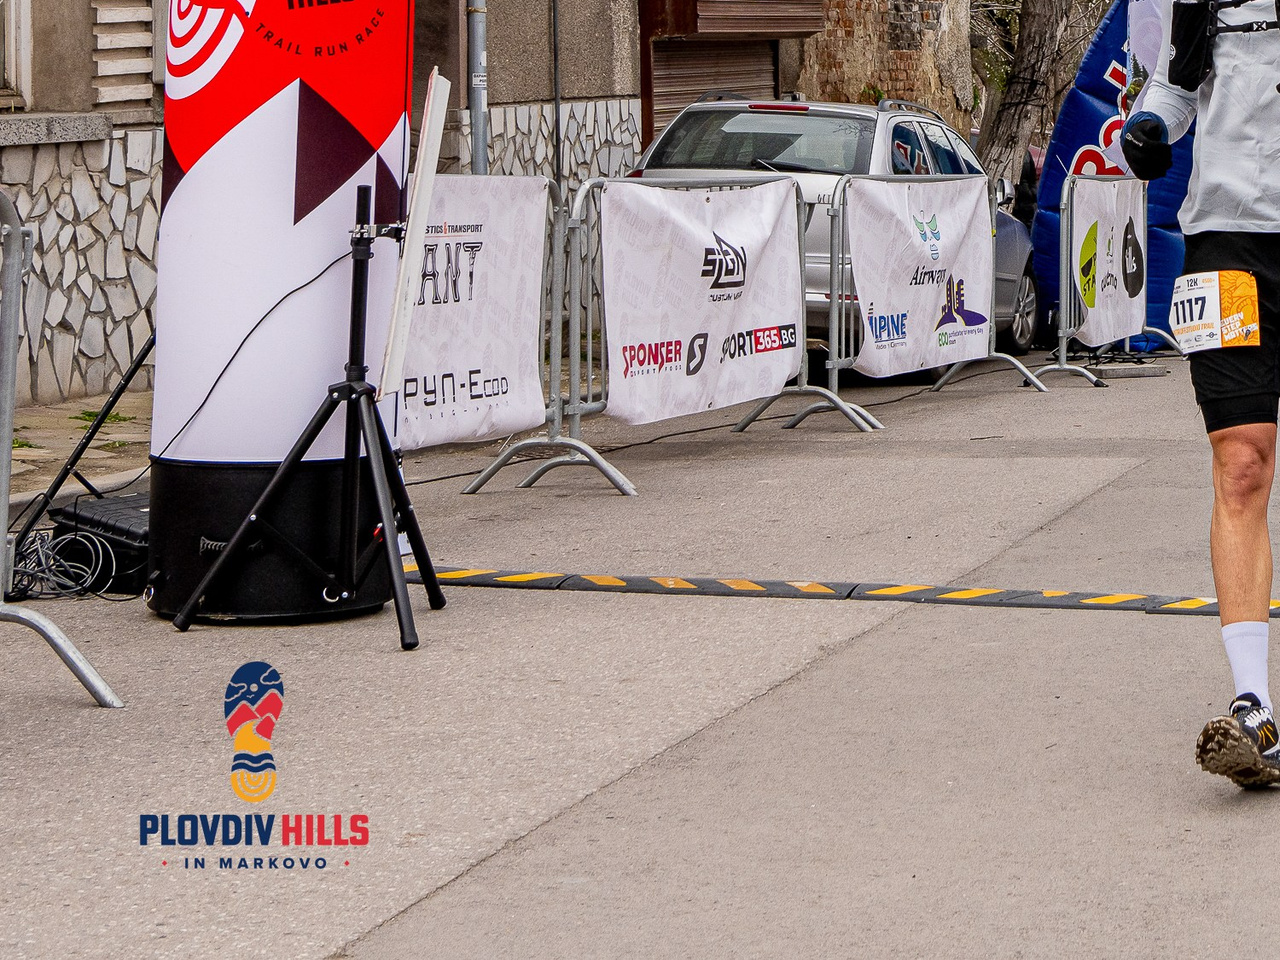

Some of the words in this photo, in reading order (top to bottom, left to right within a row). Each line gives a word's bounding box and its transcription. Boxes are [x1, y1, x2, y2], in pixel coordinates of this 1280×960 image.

[255, 23, 302, 55] TRAIL
[314, 41, 349, 57] RUN
[355, 8, 385, 44] RACE
[425, 225, 443, 235] STICS
[447, 224, 483, 234] TRANSPORT
[418, 242, 483, 306] ANT
[1186, 278, 1198, 288] 12K
[1173, 296, 1206, 325] 1117
[622, 340, 683, 378] SPONSER
